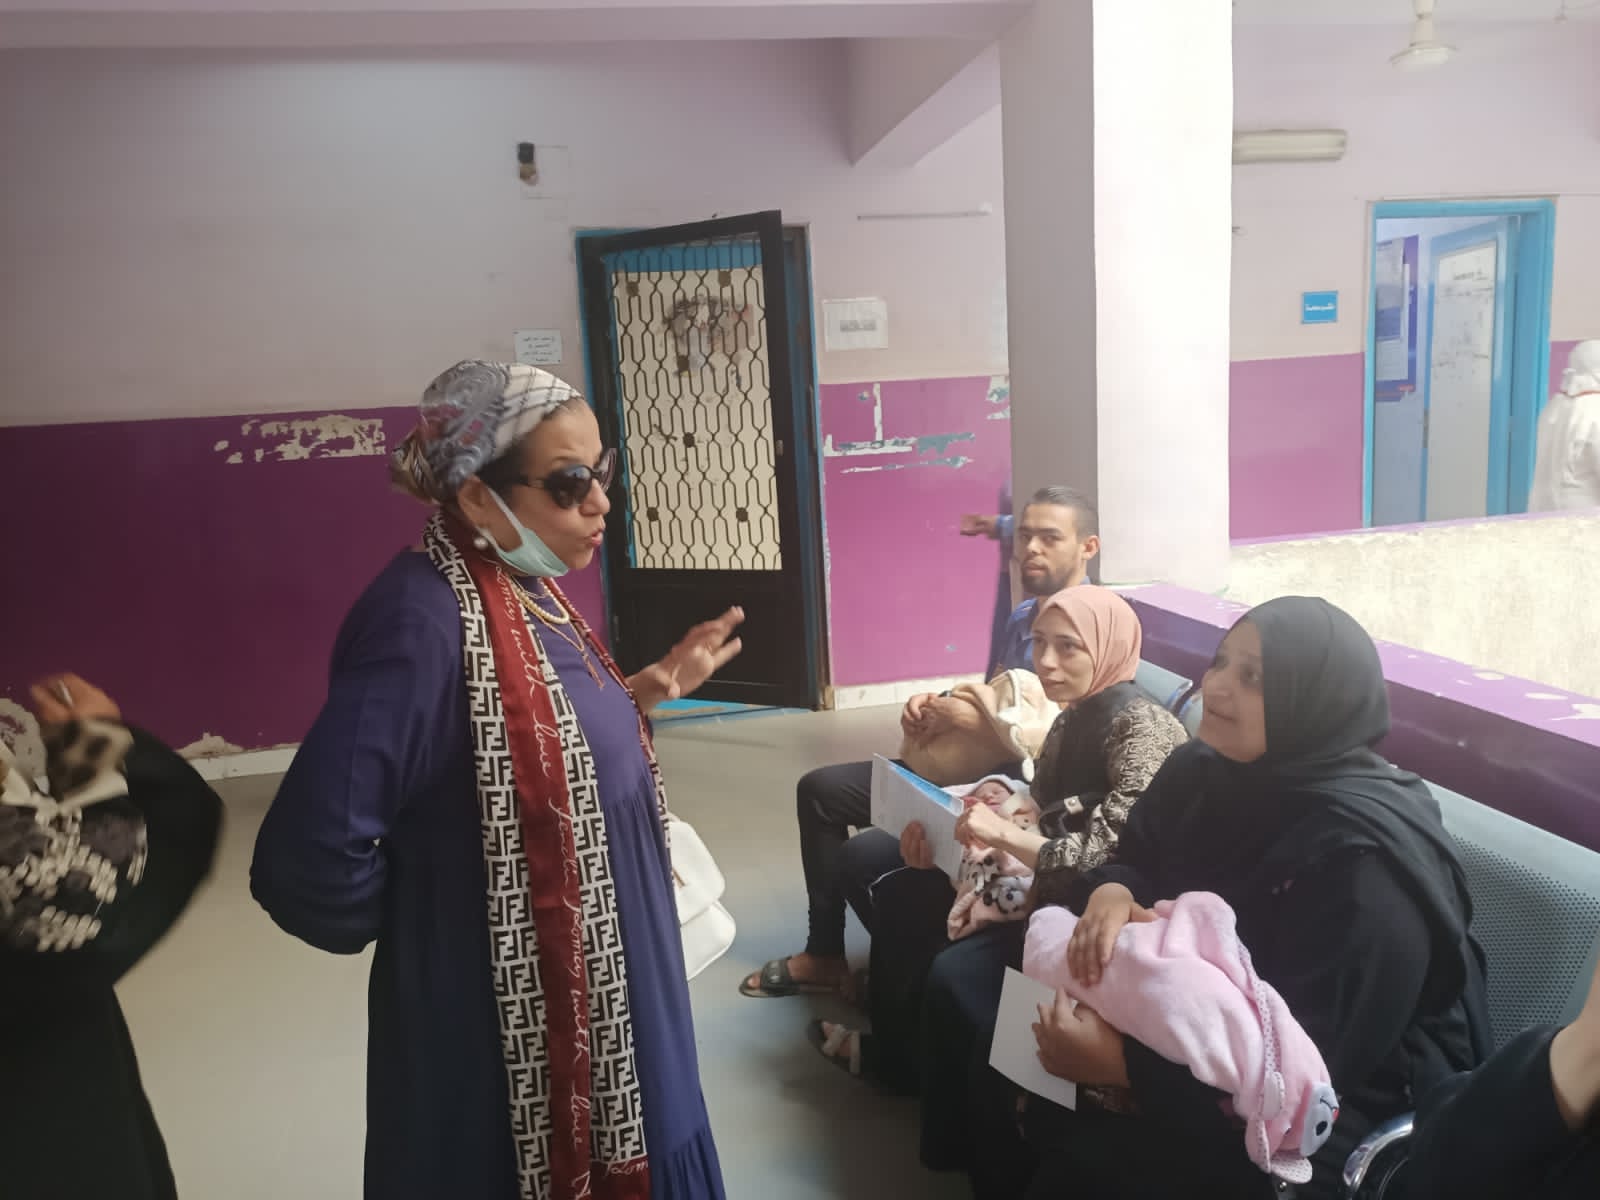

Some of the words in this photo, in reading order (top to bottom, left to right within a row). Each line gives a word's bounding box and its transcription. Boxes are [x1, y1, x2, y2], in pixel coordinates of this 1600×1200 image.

[511, 629, 548, 698] with
[533, 708, 559, 777] love
[570, 989, 590, 1065] with
[571, 1080, 591, 1149] love
